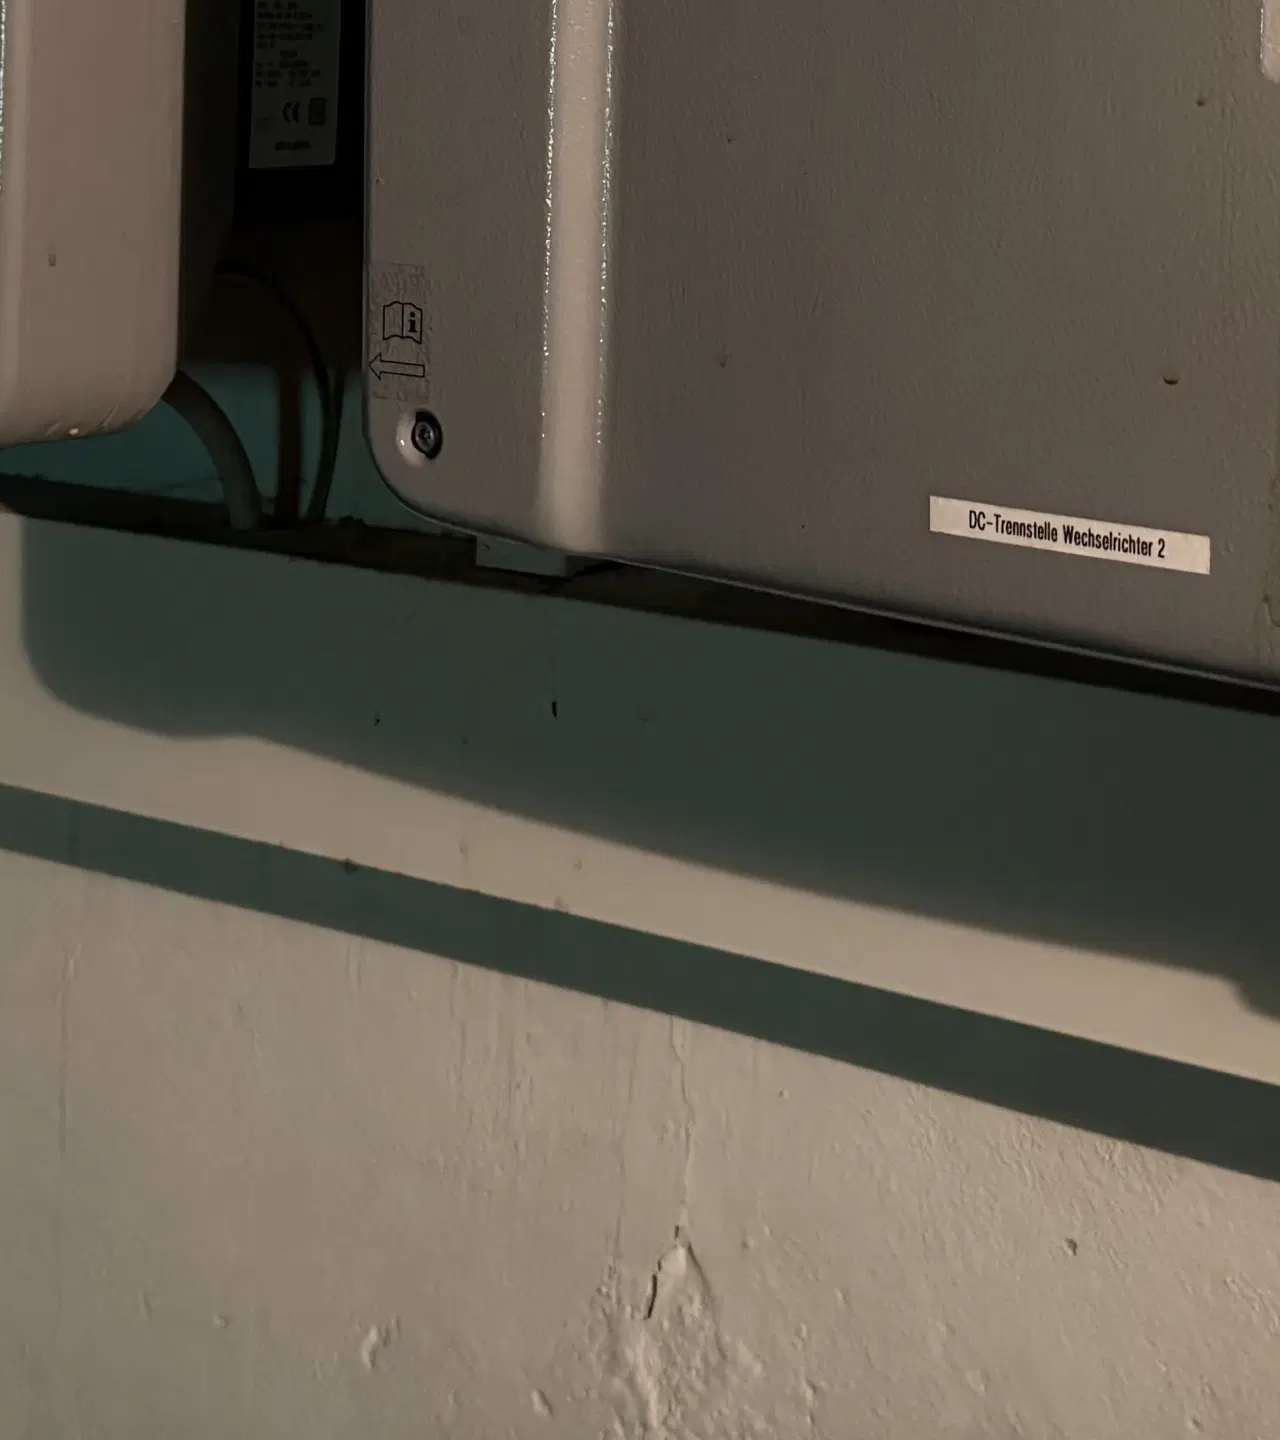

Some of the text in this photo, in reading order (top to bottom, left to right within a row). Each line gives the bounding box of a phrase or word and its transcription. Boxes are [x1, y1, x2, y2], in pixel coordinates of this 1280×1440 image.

[969, 510, 1166, 558] DC-Trennstelle Wechselrichter 2
